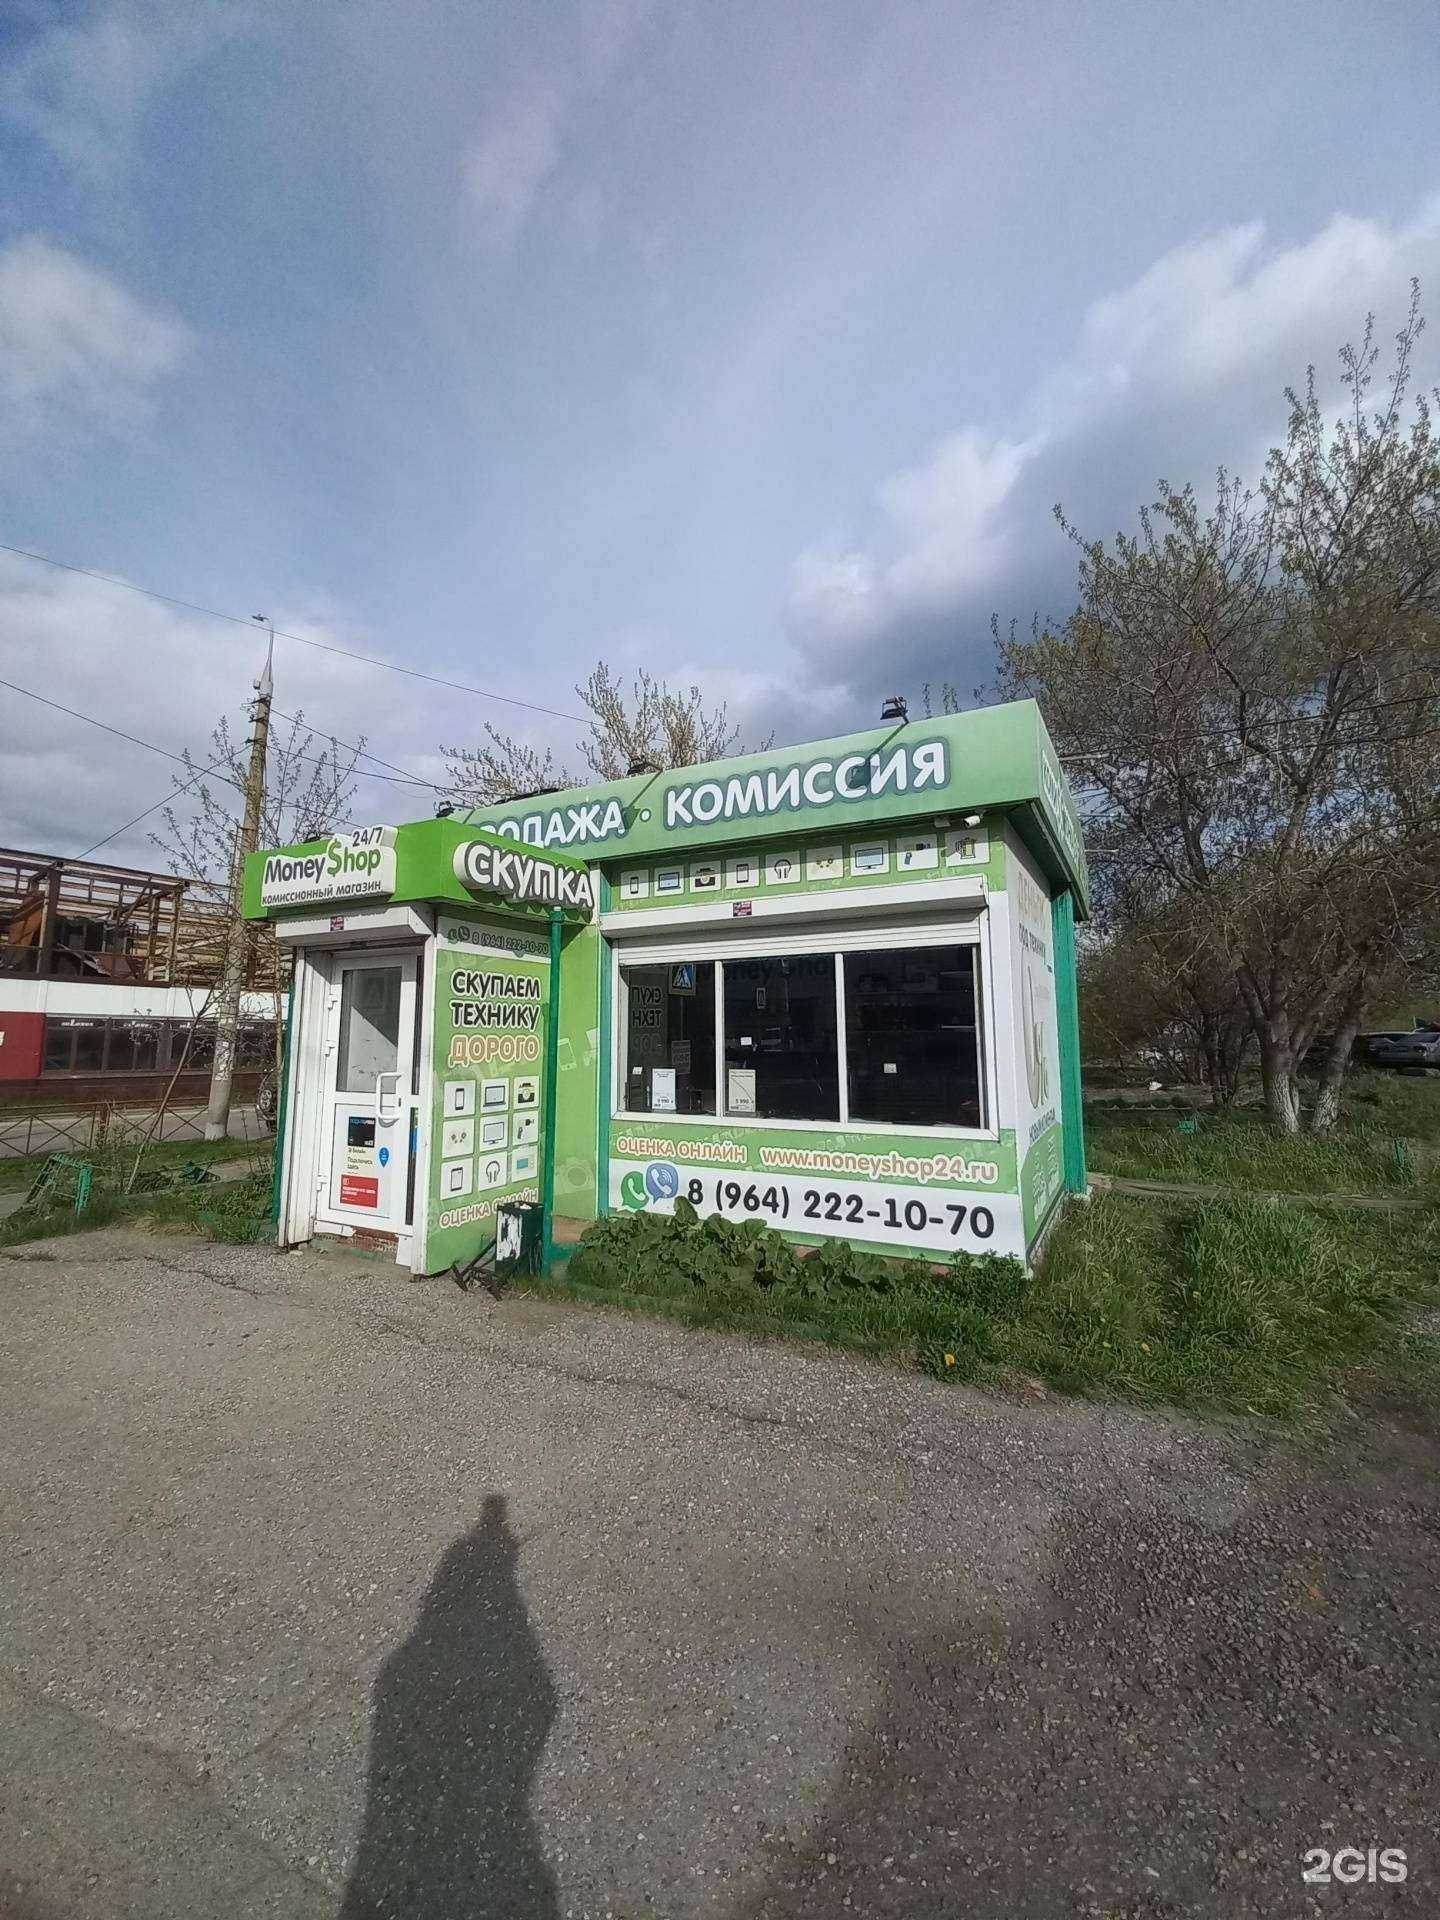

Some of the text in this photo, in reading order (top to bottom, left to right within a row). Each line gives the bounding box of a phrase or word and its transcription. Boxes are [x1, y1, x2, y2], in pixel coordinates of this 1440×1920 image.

[480, 741, 947, 848] ОДАЖА КОМИССИЯ
[352, 827, 384, 847] 24/7
[466, 844, 594, 907] СКУПКА
[262, 880, 382, 905] комиссионный магазин
[472, 932, 549, 955] 8 (964) 222-10-70
[451, 970, 541, 1000] СКУПАЕМ
[450, 1001, 541, 1030] ТЕХНИКУ
[449, 1034, 540, 1067] ДОРОГО
[618, 1137, 748, 1163] ОЦЕНКА ОНЛАЙН
[760, 1146, 999, 1185] www.moneyshop24.ru
[440, 1203, 490, 1229] ОЦЕНКА
[687, 1177, 995, 1239] 8 (964) 222-10-70
